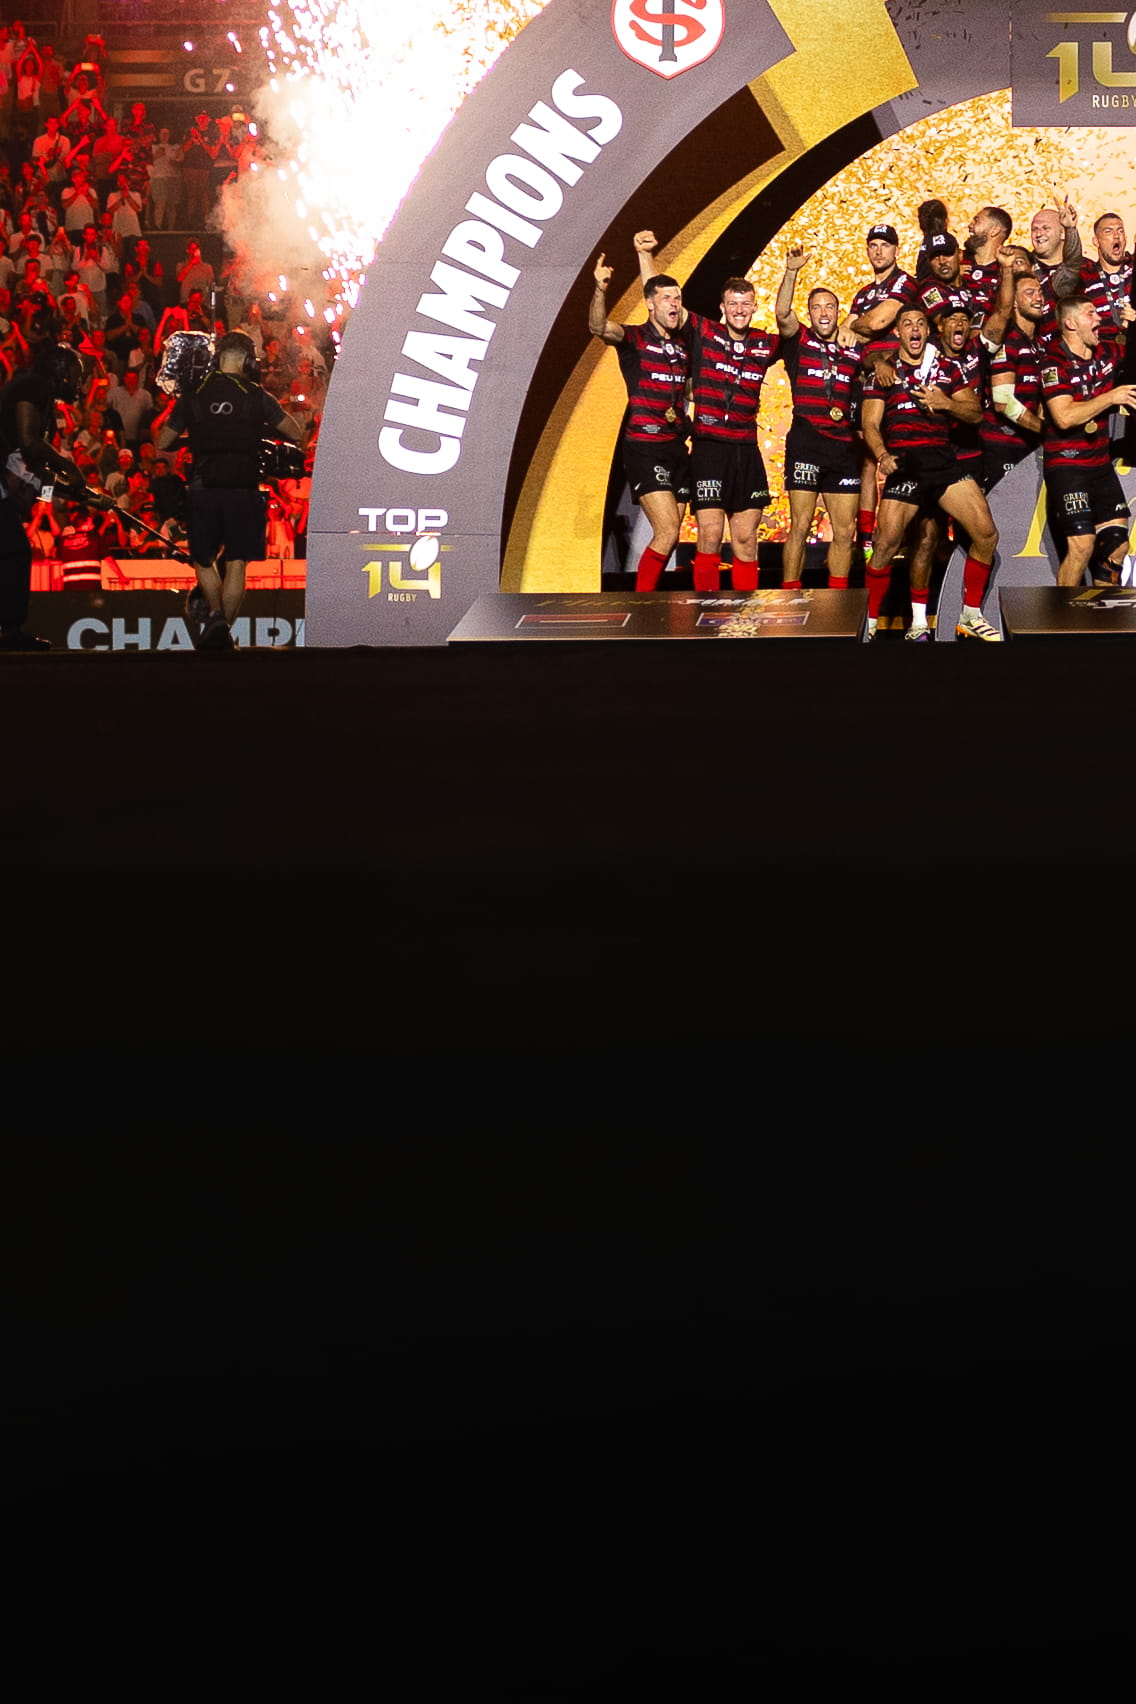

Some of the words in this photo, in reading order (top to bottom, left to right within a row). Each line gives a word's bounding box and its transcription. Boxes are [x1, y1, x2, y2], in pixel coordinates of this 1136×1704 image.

[378, 68, 623, 476] CHAMPIONS
[697, 487, 721, 498] CITY
[1065, 500, 1089, 511] CITY
[358, 508, 449, 533] TOP
[361, 561, 441, 599] 14
[388, 592, 417, 602] RUGBY
